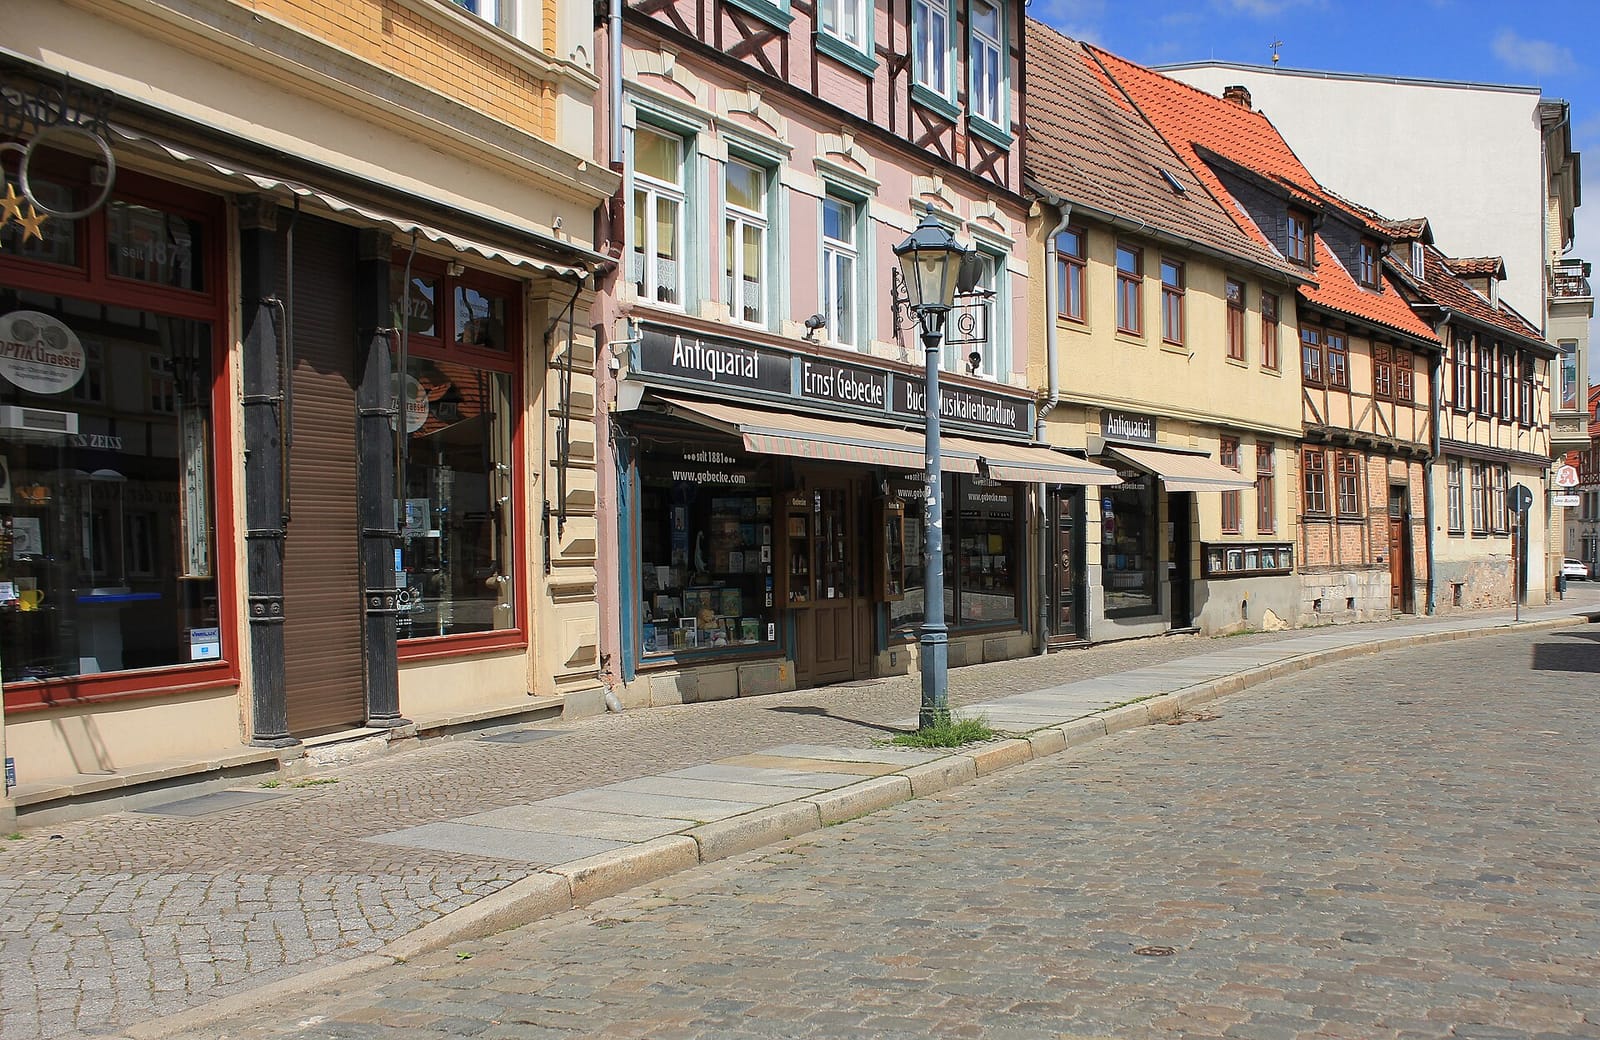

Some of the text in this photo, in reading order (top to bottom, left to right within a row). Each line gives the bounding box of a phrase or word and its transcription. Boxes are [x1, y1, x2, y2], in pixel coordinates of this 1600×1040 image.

[35, 340, 81, 369] Graeser
[672, 334, 759, 381] Antiquariat
[804, 362, 882, 405] Ernst Gebecke
[1107, 413, 1151, 440] Antiquariat
[90, 434, 122, 449] ZEISS
[708, 451, 724, 464] 1881
[672, 470, 746, 484] www.gebecke.com
